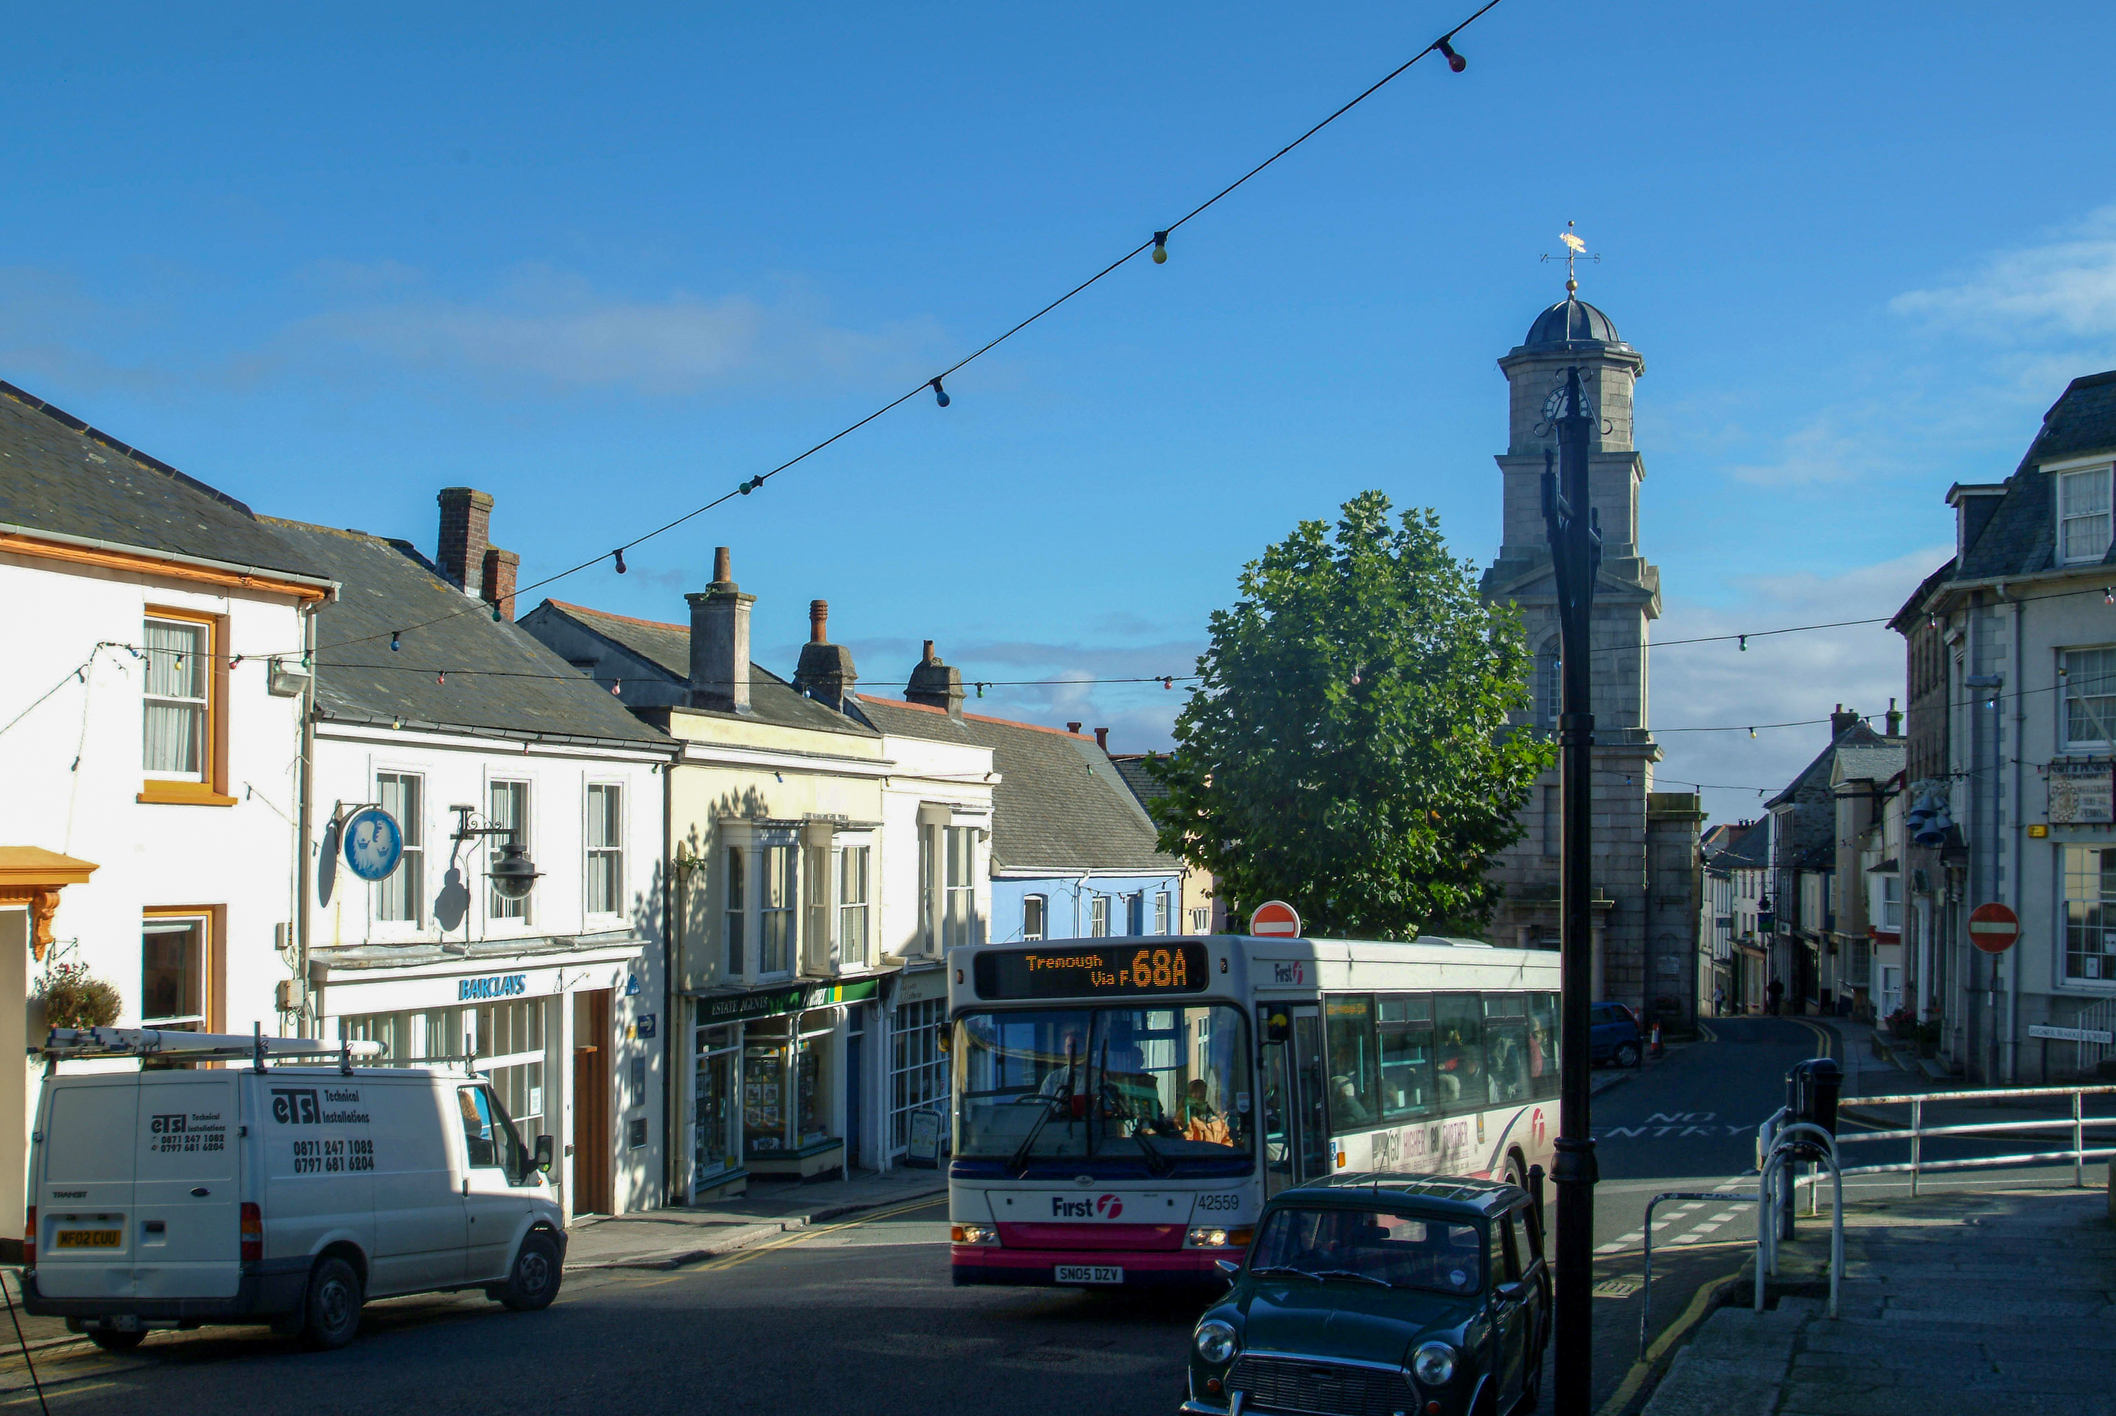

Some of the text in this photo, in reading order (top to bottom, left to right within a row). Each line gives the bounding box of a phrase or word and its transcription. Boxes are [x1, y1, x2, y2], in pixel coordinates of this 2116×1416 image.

[1132, 948, 1187, 988] 68A
[1275, 963, 1292, 983] First
[1090, 971, 1115, 987] Via
[459, 974, 526, 1001] BARCLAYS
[711, 997, 768, 1016] ESTATE AGENTS
[2030, 1027, 2056, 1037] HIGHER
[2057, 1029, 2085, 1039] MARKET
[324, 1089, 359, 1102] Technical
[192, 1112, 220, 1121] Technical
[322, 1110, 370, 1123] Installations
[1644, 1112, 1716, 1123] NO
[187, 1124, 226, 1132] Installations
[161, 1134, 225, 1143] 0871 247 1082
[1403, 1129, 1426, 1159] HIGHER
[1442, 1121, 1469, 1150] FURTHER
[161, 1143, 224, 1152] 0797 681 6204
[293, 1140, 373, 1156] 0871 247 1082
[294, 1156, 374, 1173] 0797 681 6204
[53, 1191, 88, 1199] TRANSIT
[1198, 1194, 1239, 1210] 42559
[1052, 1197, 1093, 1217] First
[1060, 1267, 1118, 1281] SN05 DZV
